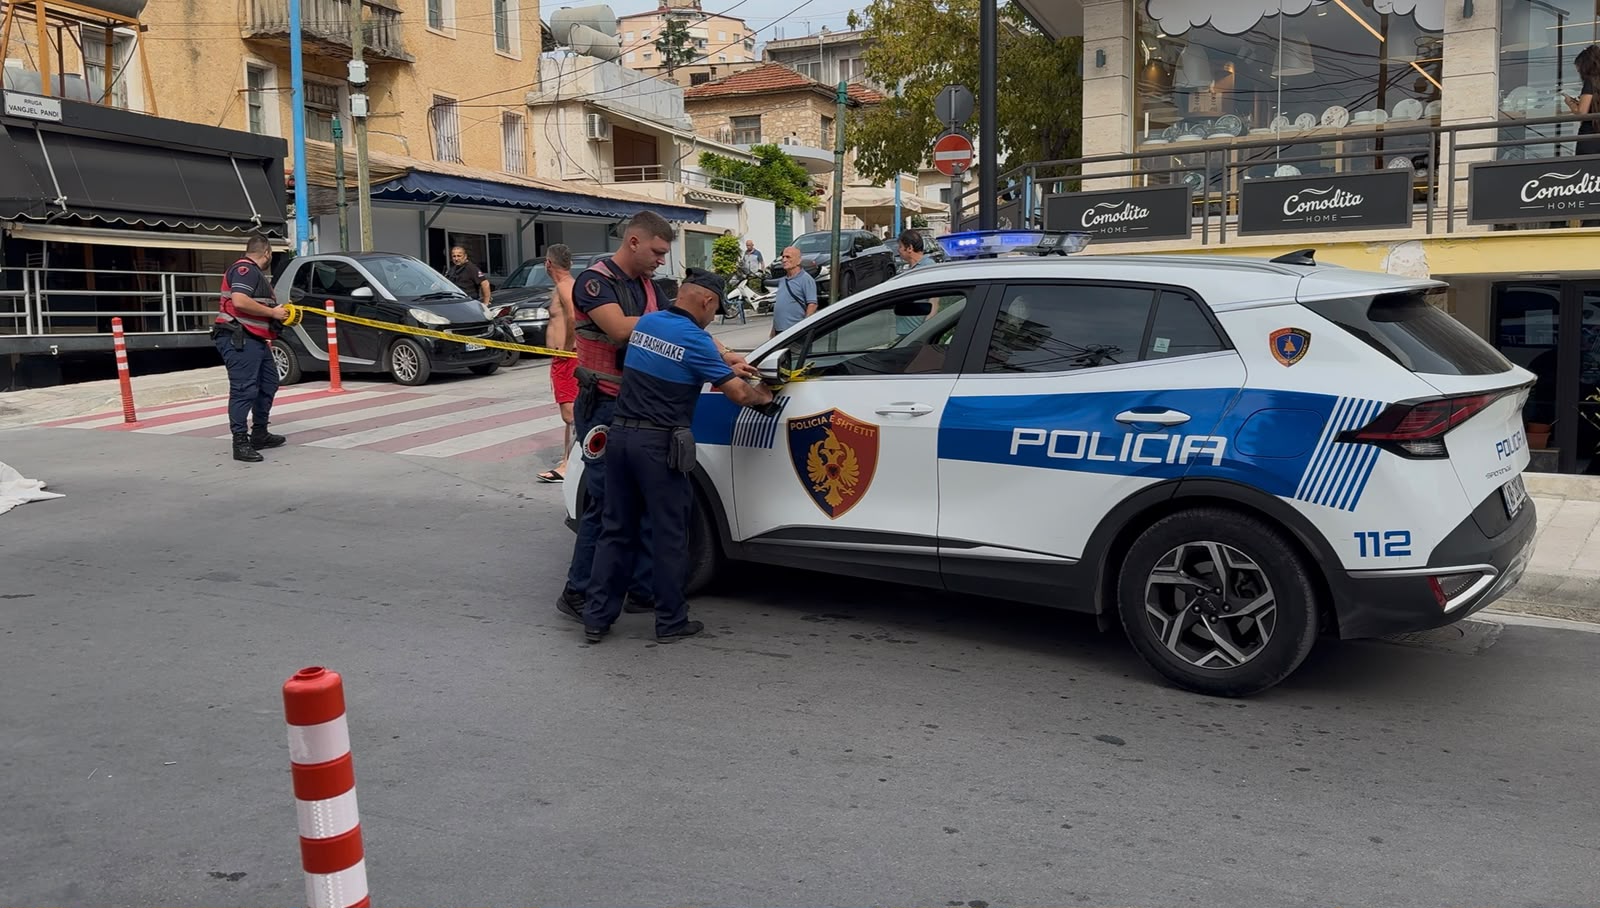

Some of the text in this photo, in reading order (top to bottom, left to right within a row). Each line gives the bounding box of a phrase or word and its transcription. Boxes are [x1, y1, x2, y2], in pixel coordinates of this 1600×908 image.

[9, 104, 59, 117] VANGJEL PANDI
[1521, 173, 1600, 203] Comodit
[1081, 202, 1150, 228] Comodita
[1283, 188, 1364, 216] Comodita
[1547, 201, 1585, 210] HOME
[1100, 226, 1128, 234] HOME
[1306, 214, 1337, 222] HOME
[642, 335, 684, 361] BASHKIAKE
[790, 414, 875, 437] POLICIA E SHTETIT
[1009, 427, 1228, 467] POLICIA
[1353, 530, 1412, 558] 112
